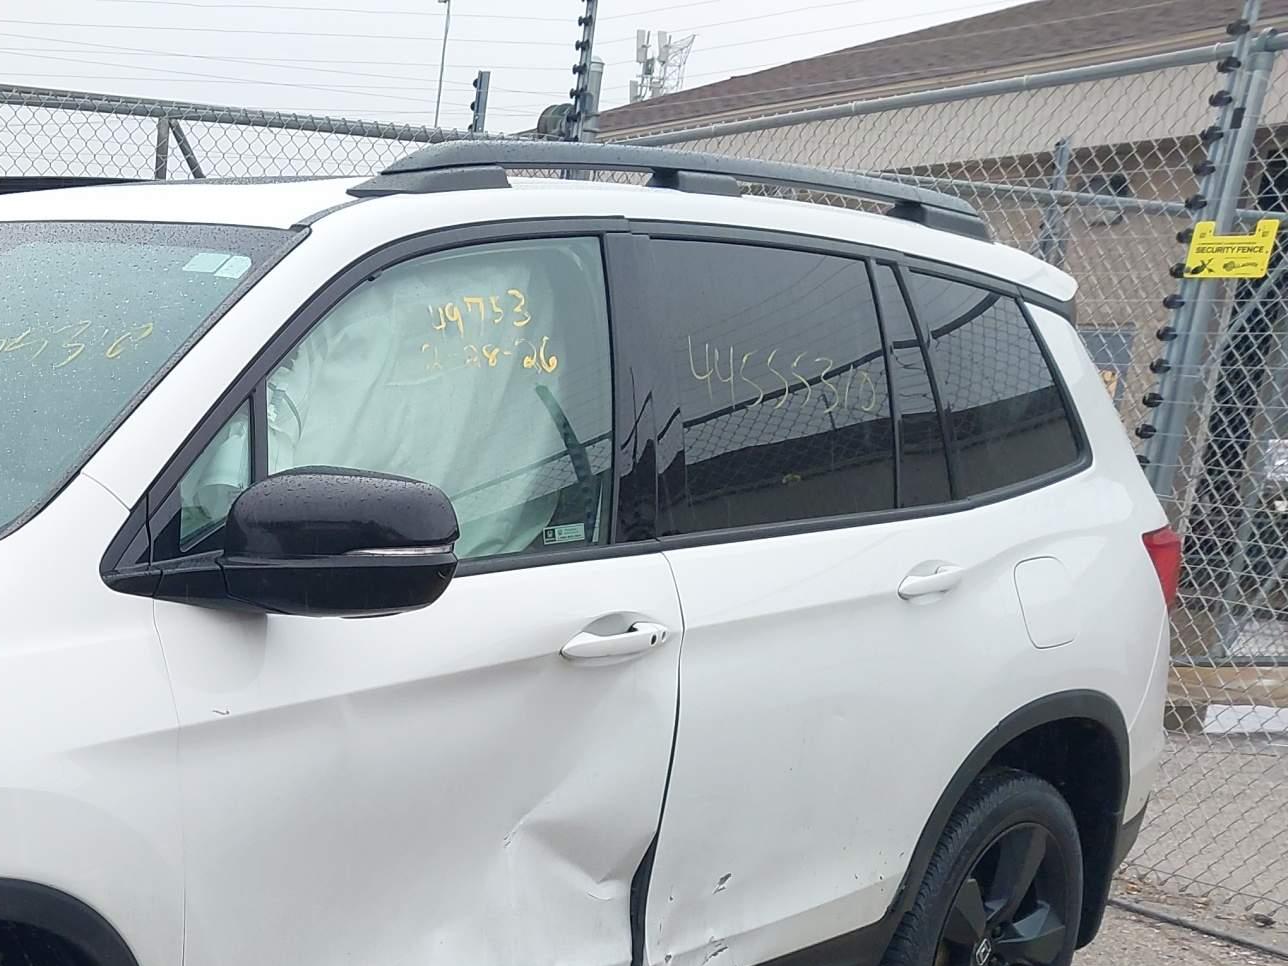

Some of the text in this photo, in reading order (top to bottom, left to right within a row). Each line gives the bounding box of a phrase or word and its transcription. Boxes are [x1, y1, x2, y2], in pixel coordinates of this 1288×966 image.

[1195, 245, 1265, 254] SECURITY FENCE
[688, 335, 876, 414] 44555310
